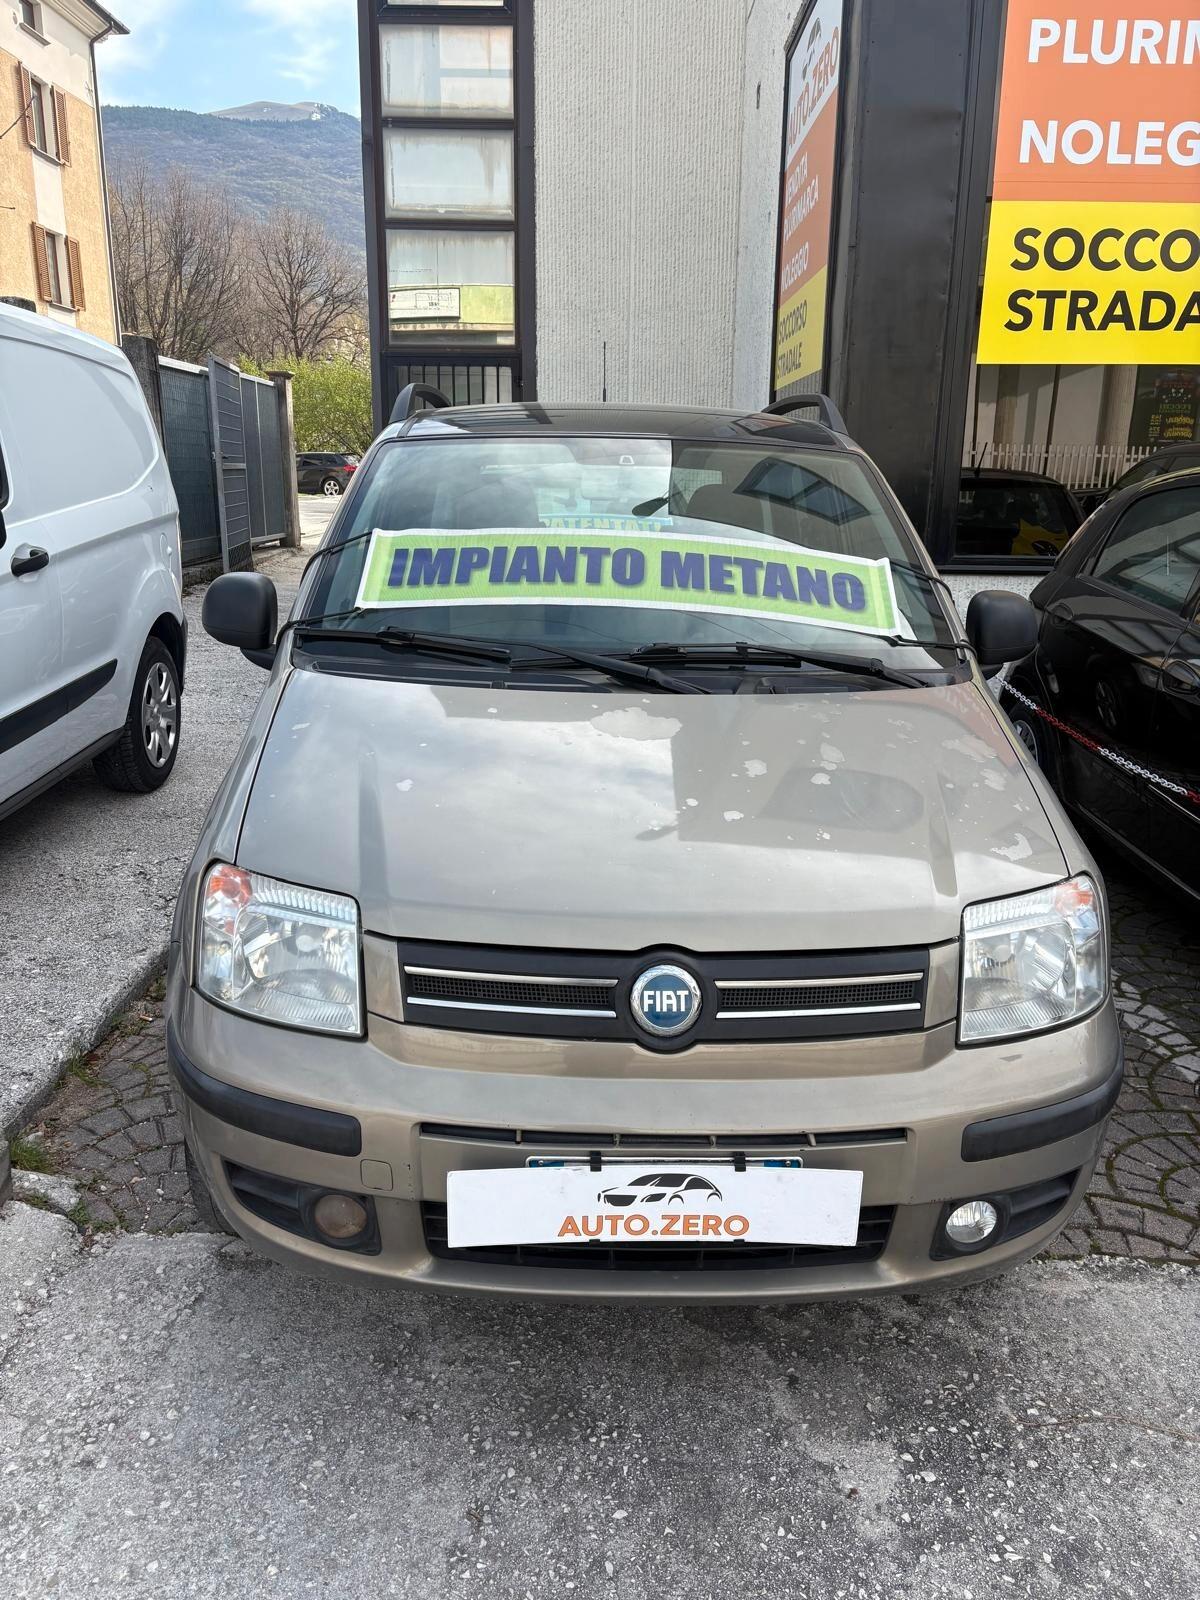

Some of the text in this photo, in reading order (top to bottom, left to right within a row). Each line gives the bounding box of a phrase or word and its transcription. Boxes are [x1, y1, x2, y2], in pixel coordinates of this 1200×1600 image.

[786, 26, 839, 151] AUTO.ZERO
[1019, 119, 1200, 166] NOLEG
[785, 152, 808, 208] VENDITA
[783, 174, 819, 244] PLURIMARCA
[780, 241, 809, 296] NOLEGGIO
[1010, 227, 1200, 272] SOCCO
[778, 299, 808, 345] SOCCORSO
[1004, 289, 1200, 332] STRADA
[776, 342, 802, 379] STRADALE
[387, 545, 866, 611] IMPIANTO METANO
[643, 990, 689, 1012] FIAT
[557, 1214, 750, 1237] AUTO.ZERO
